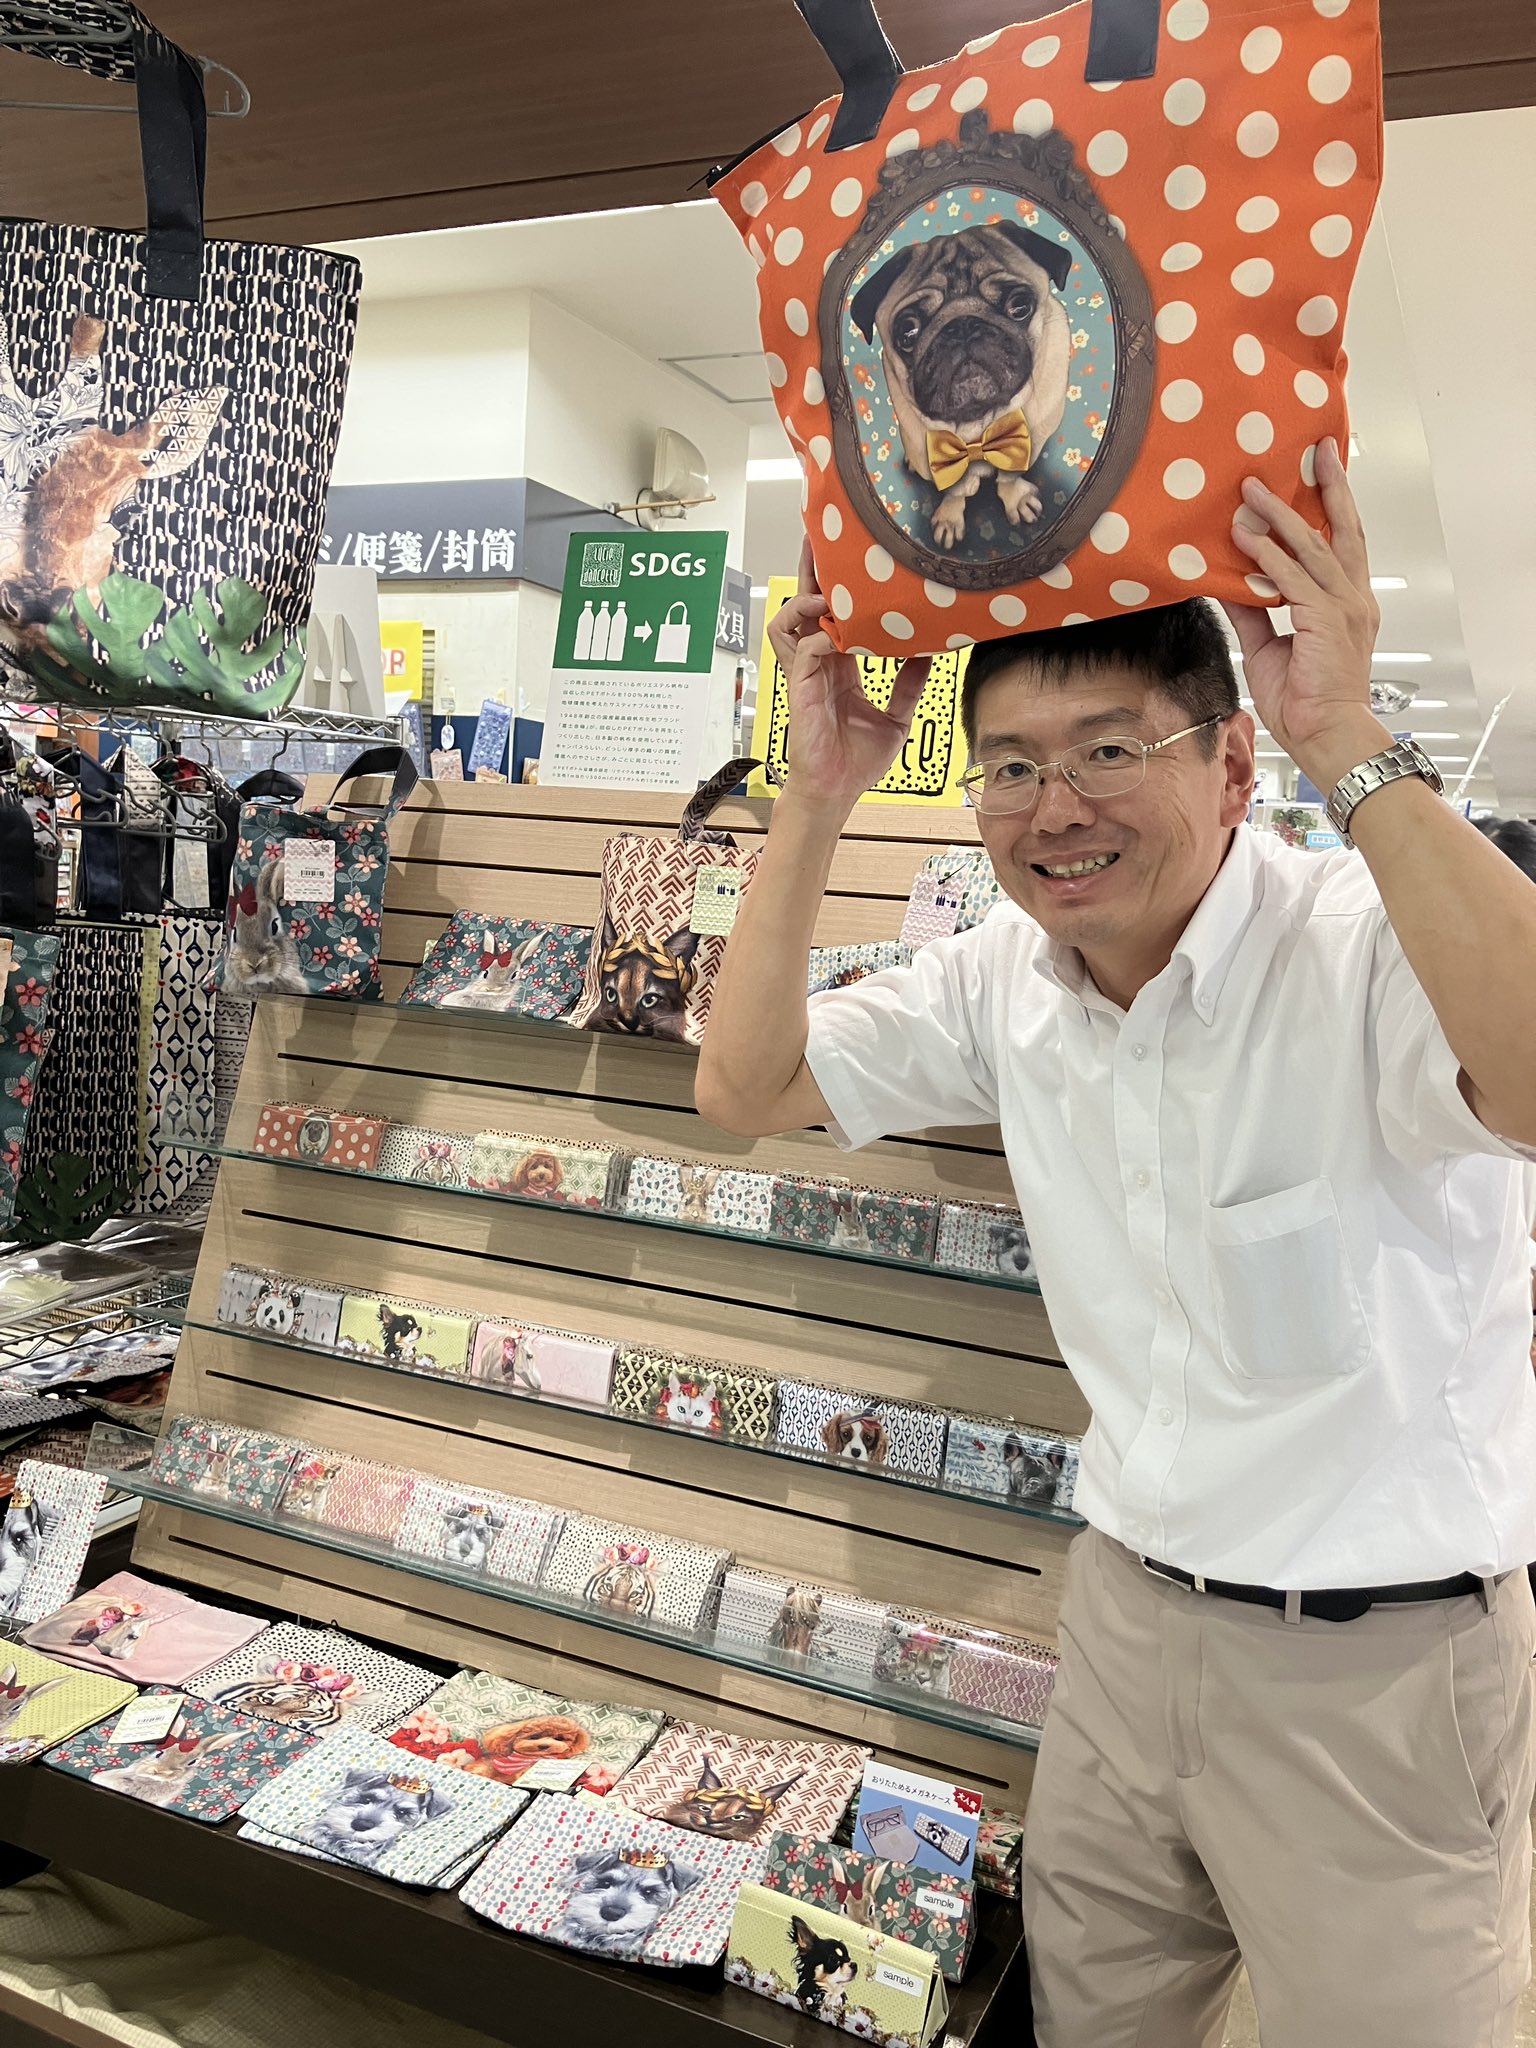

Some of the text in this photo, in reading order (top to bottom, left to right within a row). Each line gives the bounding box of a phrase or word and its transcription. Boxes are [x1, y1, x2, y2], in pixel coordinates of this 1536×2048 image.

[629, 552, 707, 577] SDGs
[871, 1775, 951, 1805] おりたためるメガネケース
[956, 1792, 978, 1810] 大人気
[923, 1895, 955, 1909] sample
[882, 1970, 914, 1988] sample
